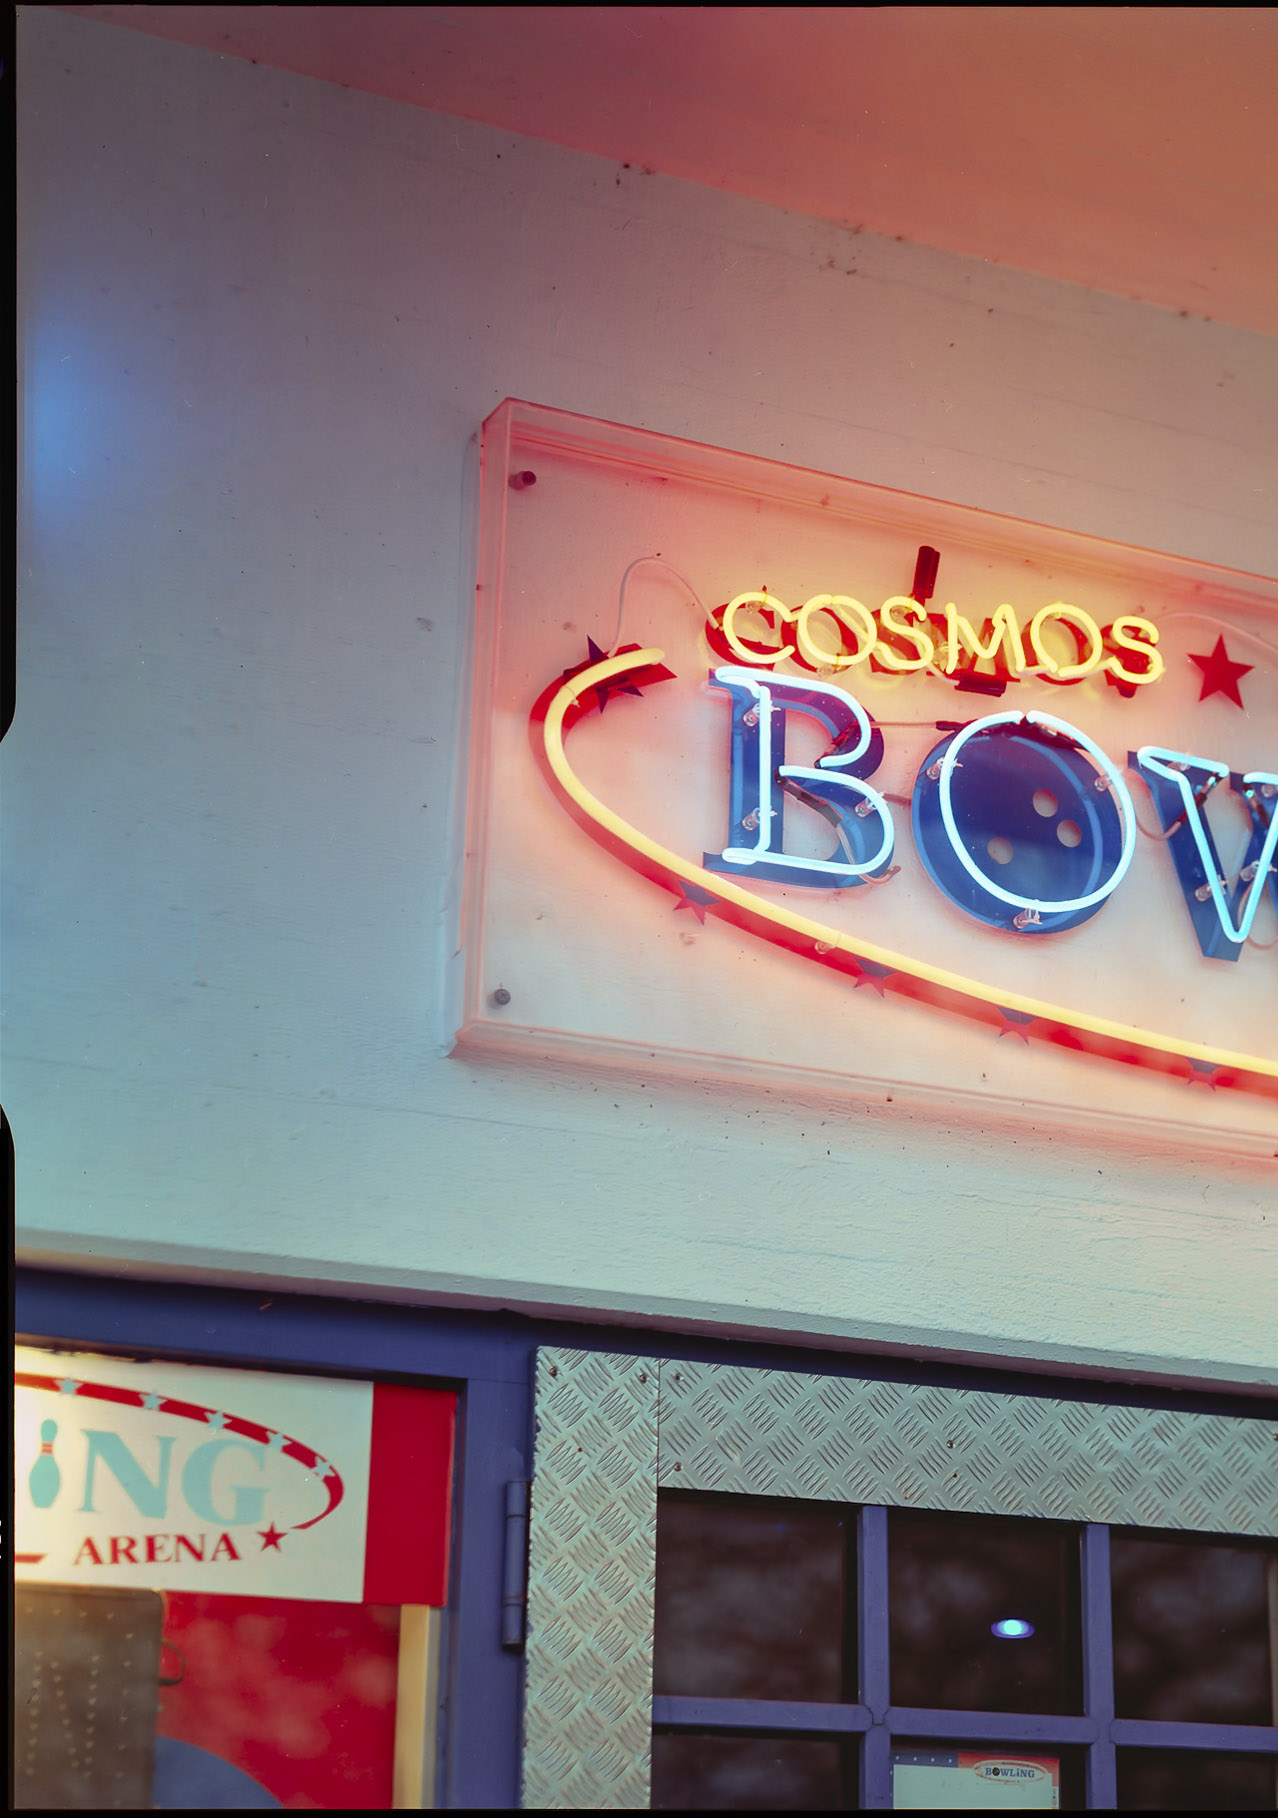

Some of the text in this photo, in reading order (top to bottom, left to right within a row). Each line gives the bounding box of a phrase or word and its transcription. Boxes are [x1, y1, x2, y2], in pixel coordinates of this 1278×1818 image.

[708, 591, 1164, 685] COSMOS
[73, 1532, 242, 1566] ARENA
[985, 1766, 1035, 1779] BOWLING
